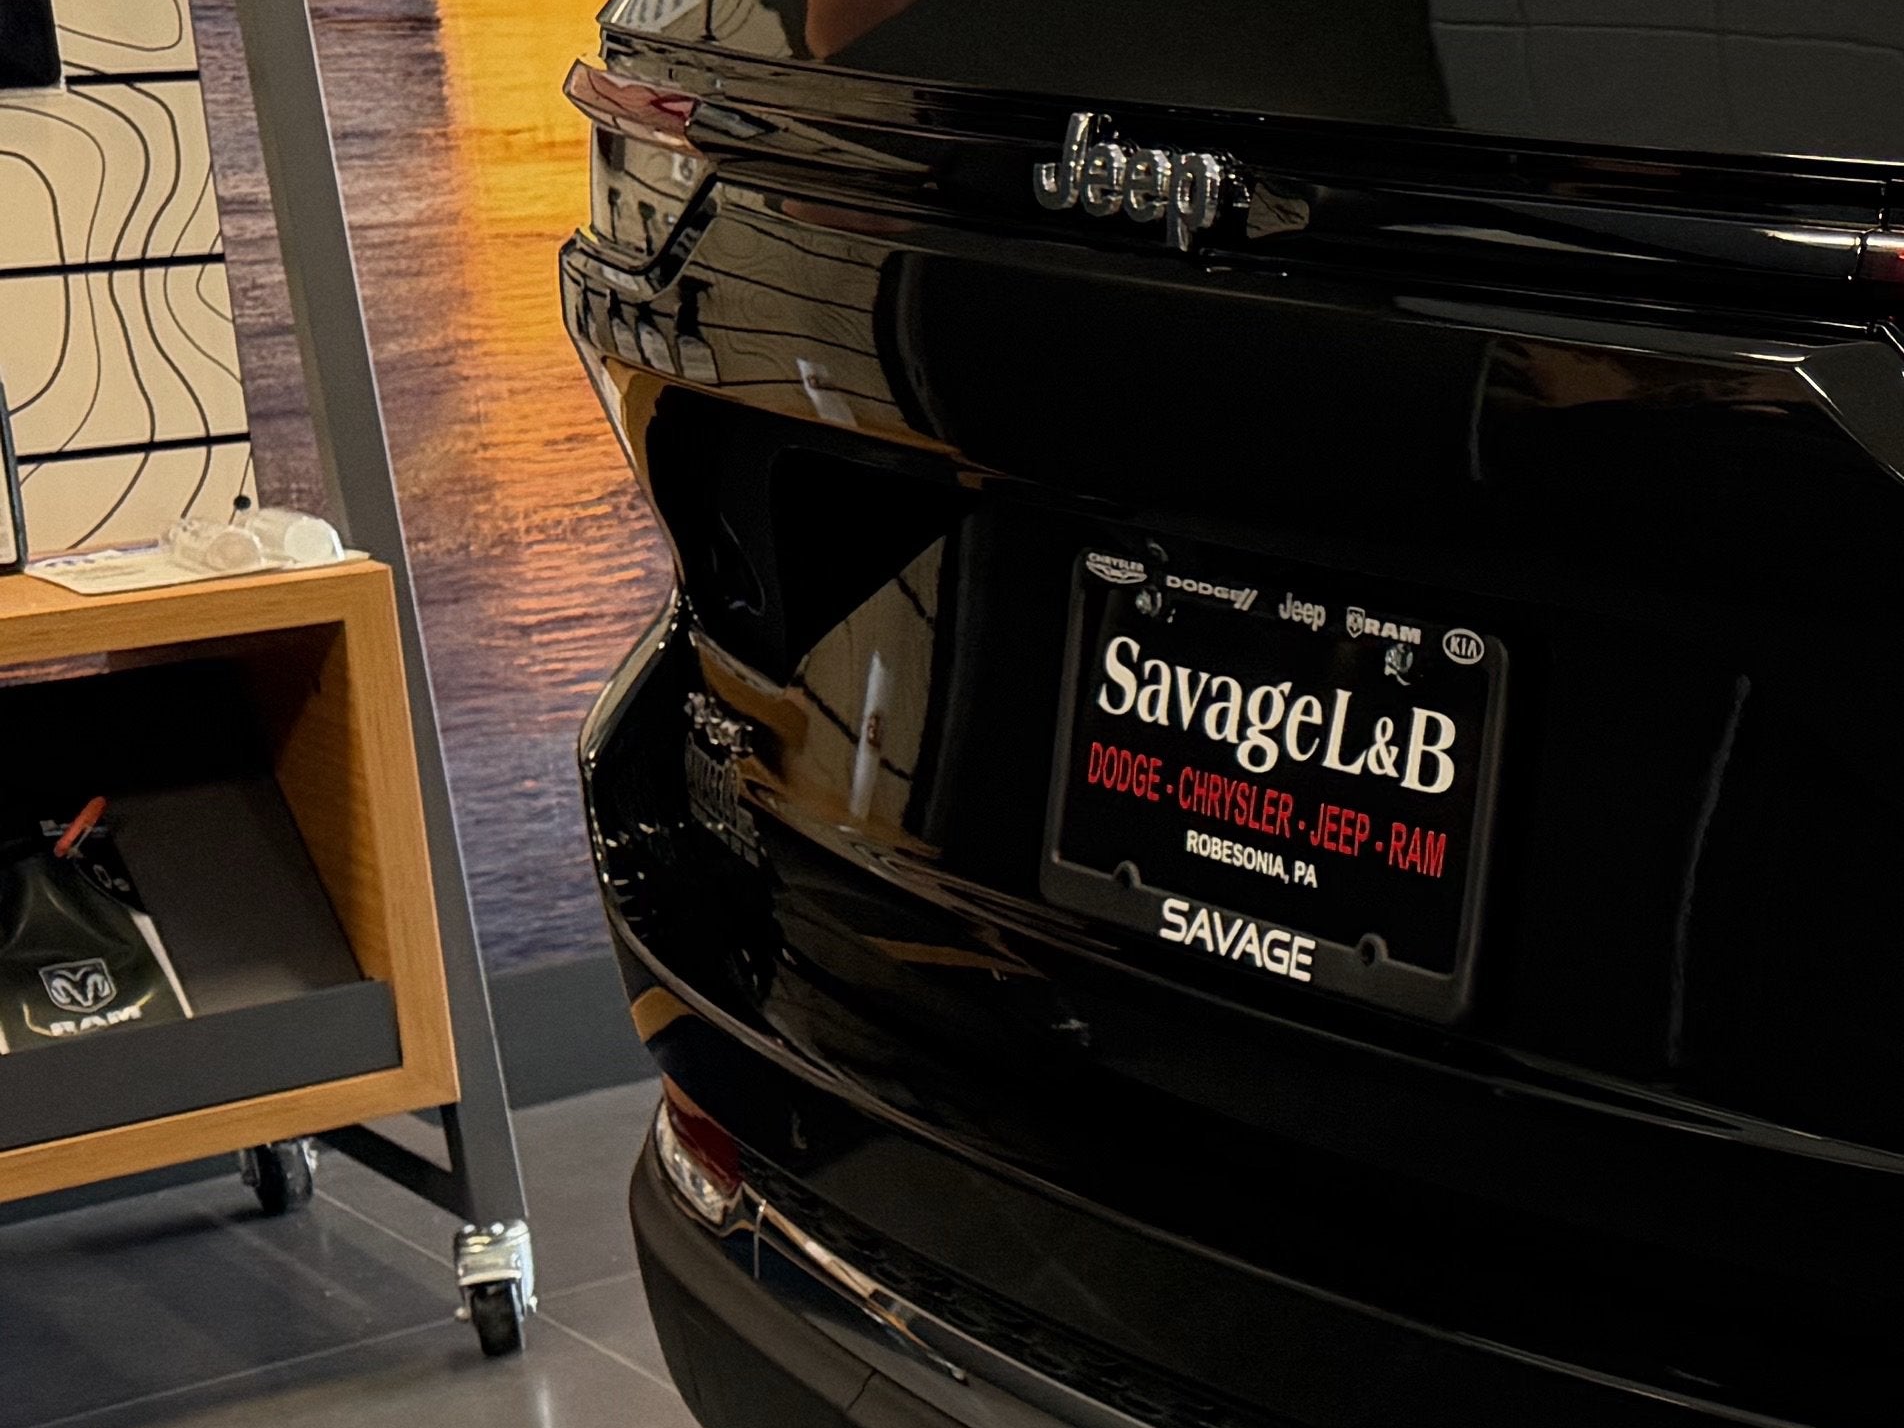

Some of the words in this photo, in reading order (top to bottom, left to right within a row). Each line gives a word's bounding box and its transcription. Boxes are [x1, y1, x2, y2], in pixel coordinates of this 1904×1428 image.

[1033, 112, 1224, 253] Jeep
[1088, 552, 1145, 573] CHRYSLER
[1166, 575, 1245, 604] DODGE
[1278, 592, 1327, 632] Jeep
[1364, 618, 1422, 645] RAM
[1088, 741, 1161, 802] DODGE
[1178, 765, 1294, 839] CHRYSLER
[1309, 802, 1371, 857] JEEP
[1388, 822, 1448, 878] RAM
[1186, 830, 1290, 884] ROBESONIA,
[1293, 861, 1319, 888] PA
[1159, 897, 1317, 983] SAVAGE
